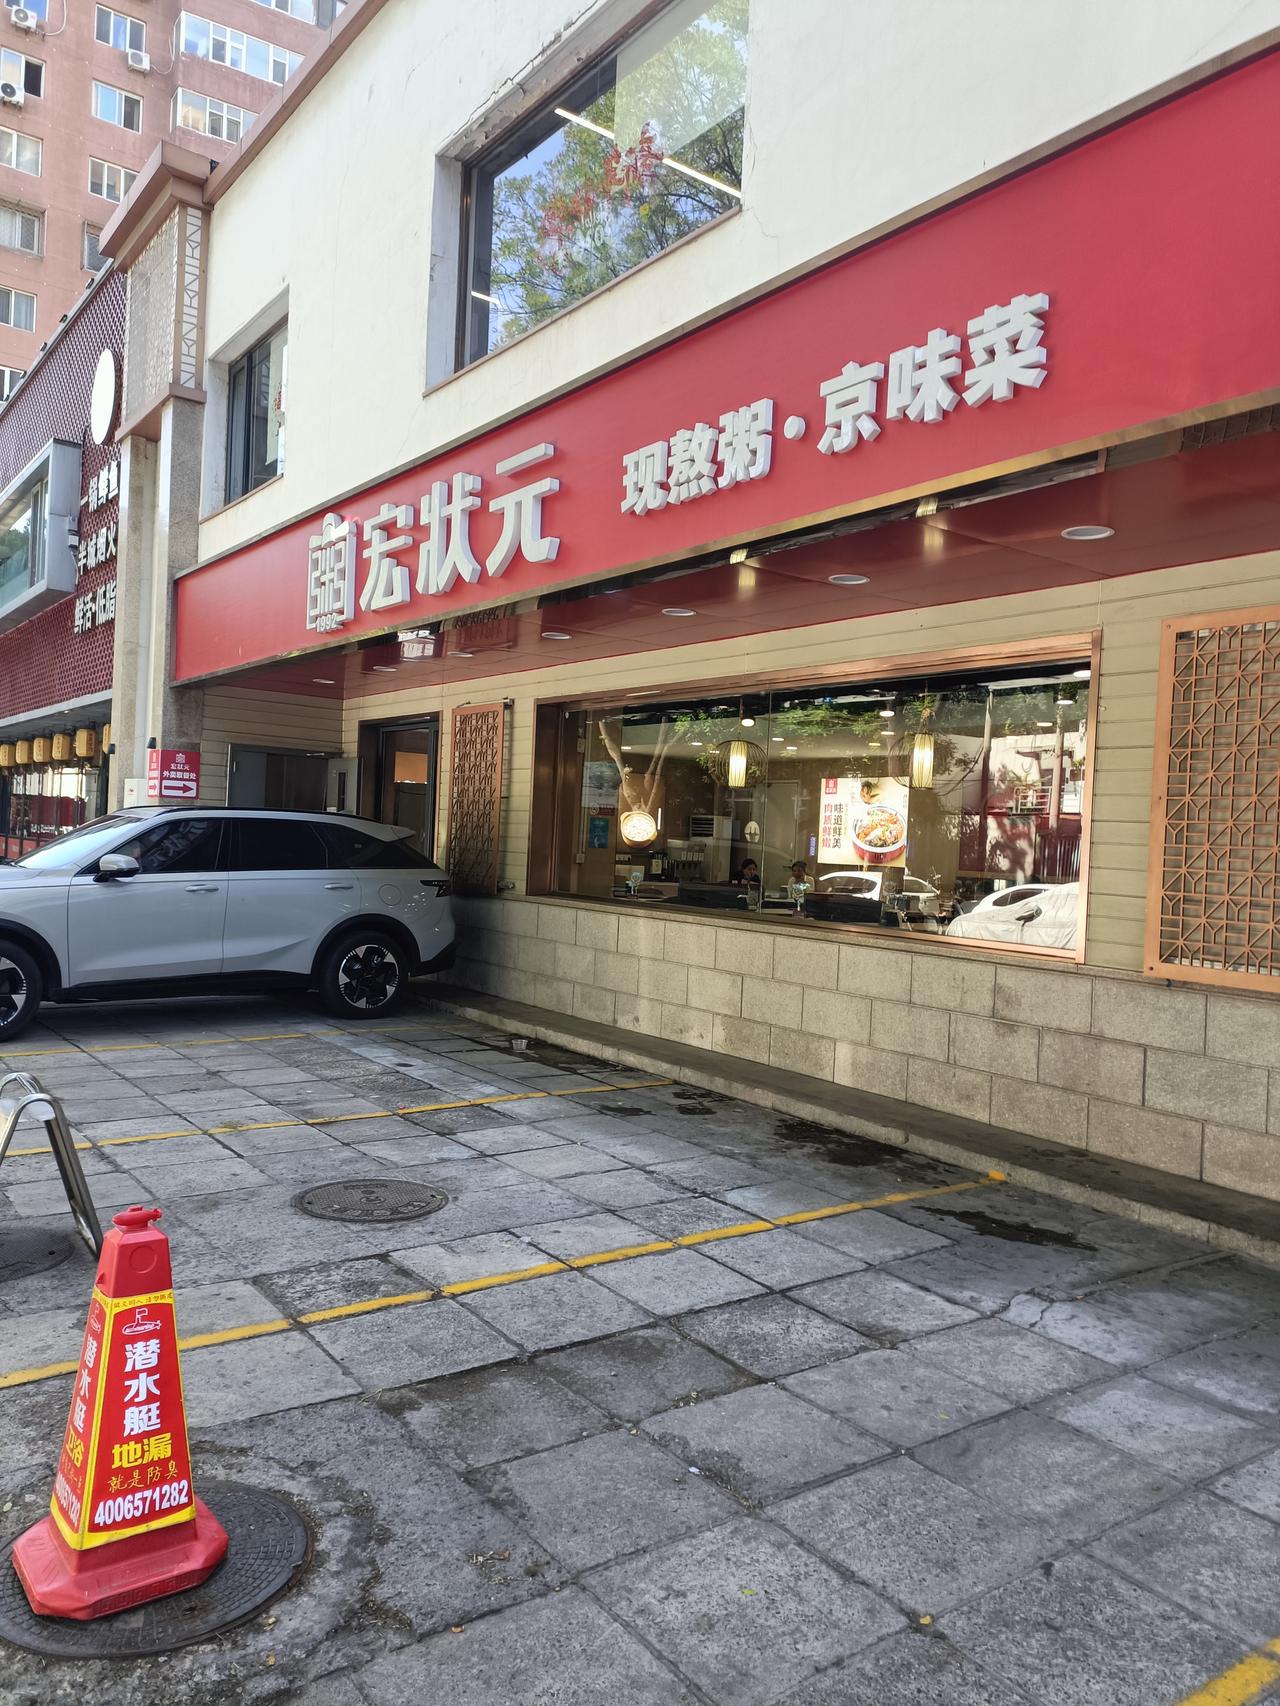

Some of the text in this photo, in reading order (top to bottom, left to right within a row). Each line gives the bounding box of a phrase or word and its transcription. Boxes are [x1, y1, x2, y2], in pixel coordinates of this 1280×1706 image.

[620, 292, 1049, 516] 现熬粥·京味菜
[315, 612, 341, 633] 1992
[832, 803, 844, 848] 味道鲜美
[123, 1338, 161, 1437] 潜水艇
[65, 1427, 85, 1468] 卫浴
[111, 1432, 172, 1469] 地漏
[94, 1479, 189, 1527] 4006571282
